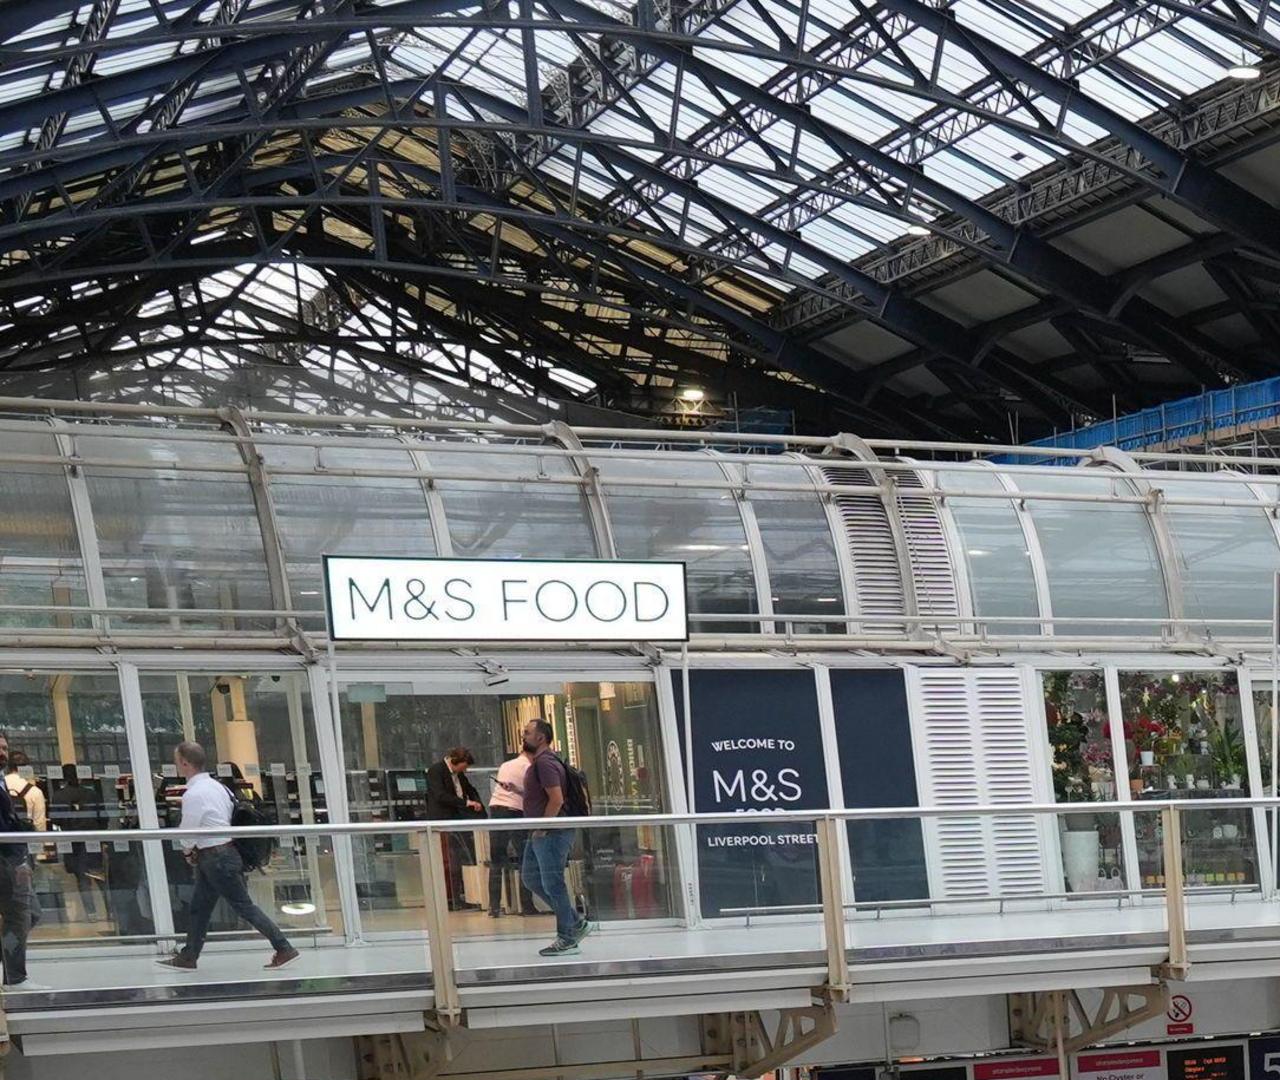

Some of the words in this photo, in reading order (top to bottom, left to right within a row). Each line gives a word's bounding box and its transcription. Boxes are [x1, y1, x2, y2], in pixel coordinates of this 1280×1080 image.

[348, 576, 475, 622] M&S
[501, 578, 670, 622] FOOD
[712, 738, 775, 752] WELCOME
[777, 739, 795, 751] TO
[712, 768, 802, 803] M&S
[707, 835, 776, 847] LIVERPOOL
[777, 833, 819, 845] STREET
[1136, 1072, 1144, 1080] or
